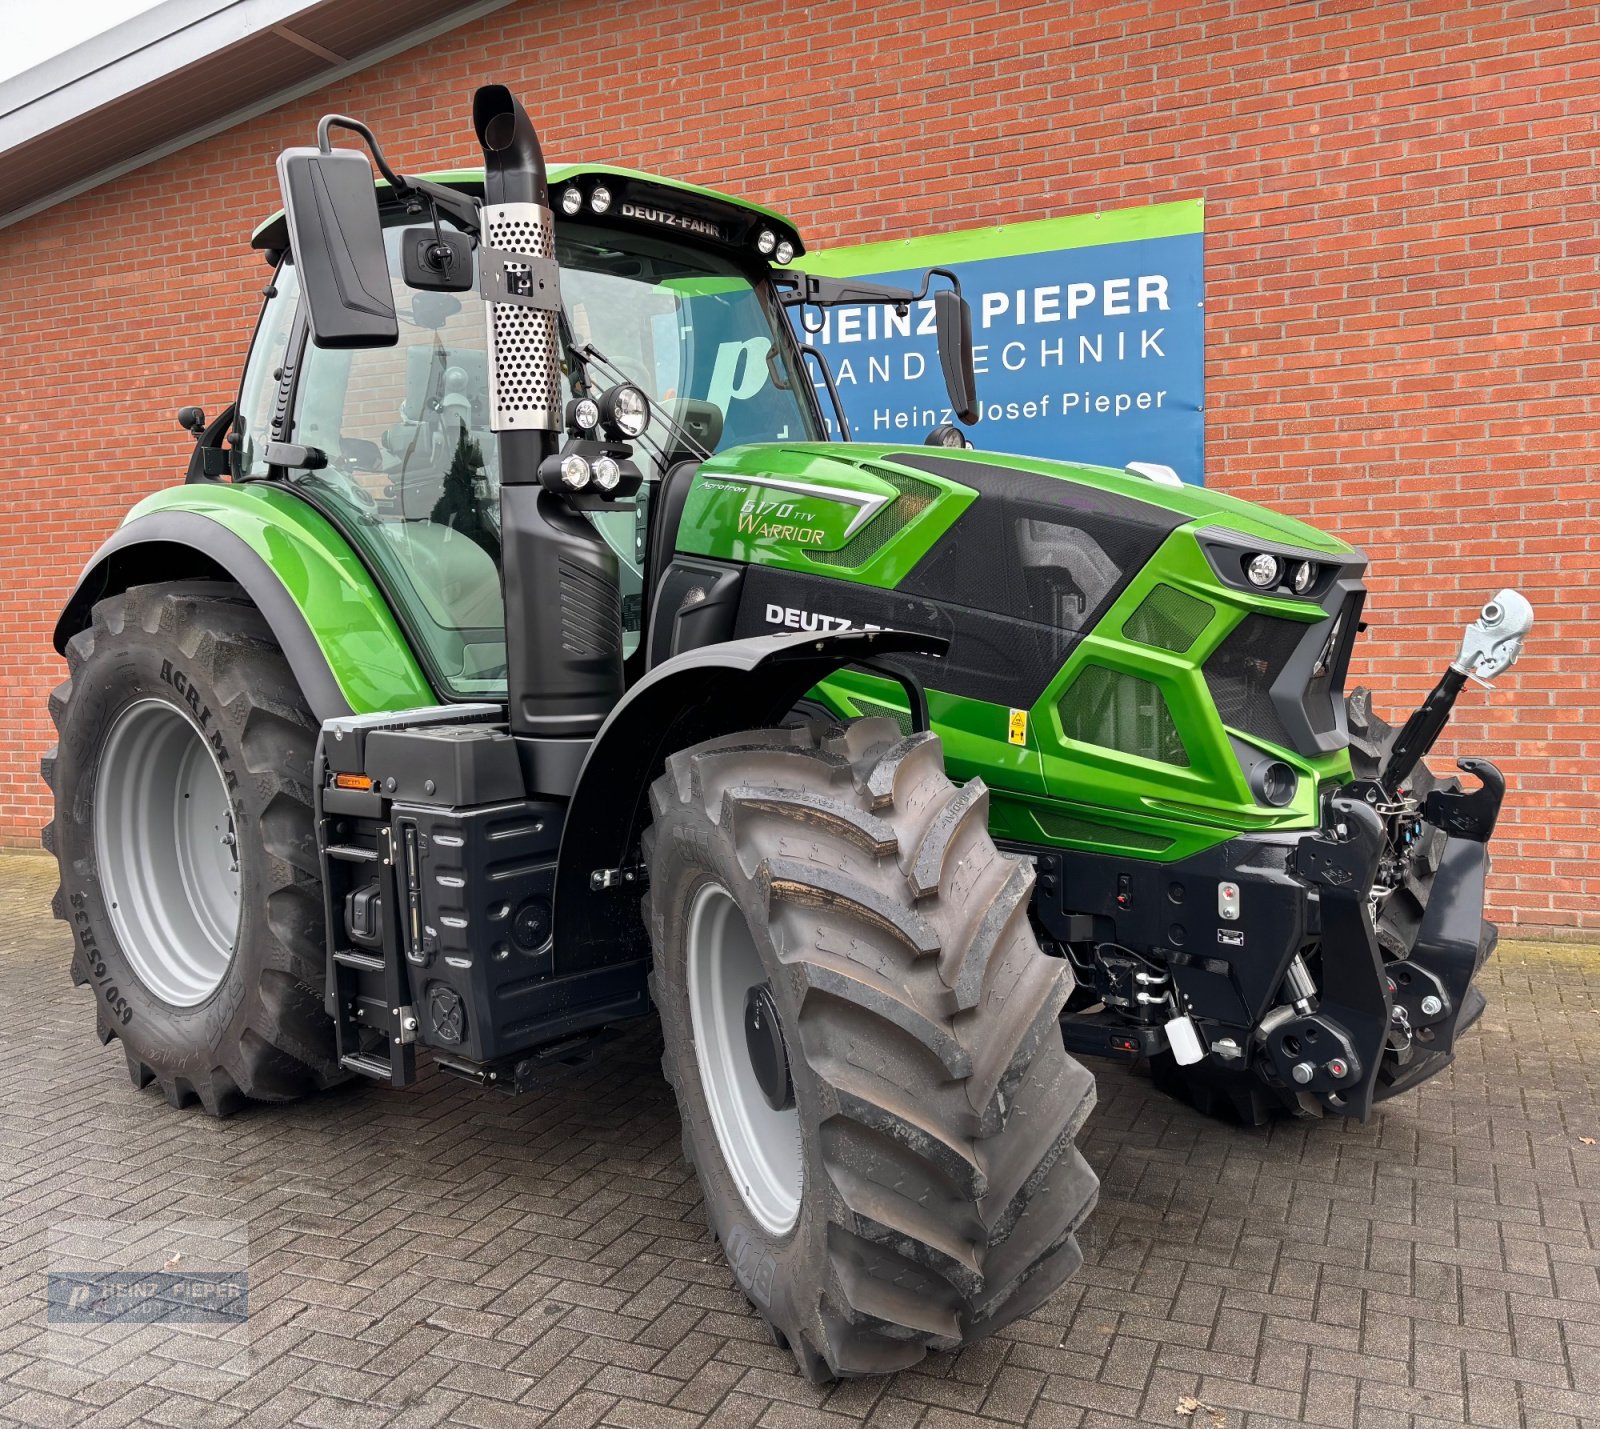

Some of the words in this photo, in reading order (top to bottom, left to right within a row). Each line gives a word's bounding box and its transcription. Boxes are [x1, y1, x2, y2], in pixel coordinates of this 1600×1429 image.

[622, 203, 720, 238] DEUTZ-FAHR
[805, 299, 938, 346] HEINZ
[982, 275, 1171, 328] PIEPER
[809, 328, 1166, 388] LANDECHNIK
[1063, 390, 1167, 416] Pieper
[696, 481, 748, 493] Agrotron
[740, 500, 794, 518] 6170
[794, 511, 816, 522] TTV
[160, 657, 249, 826] AGRIMAX
[70, 892, 133, 1026] 650/65R38
